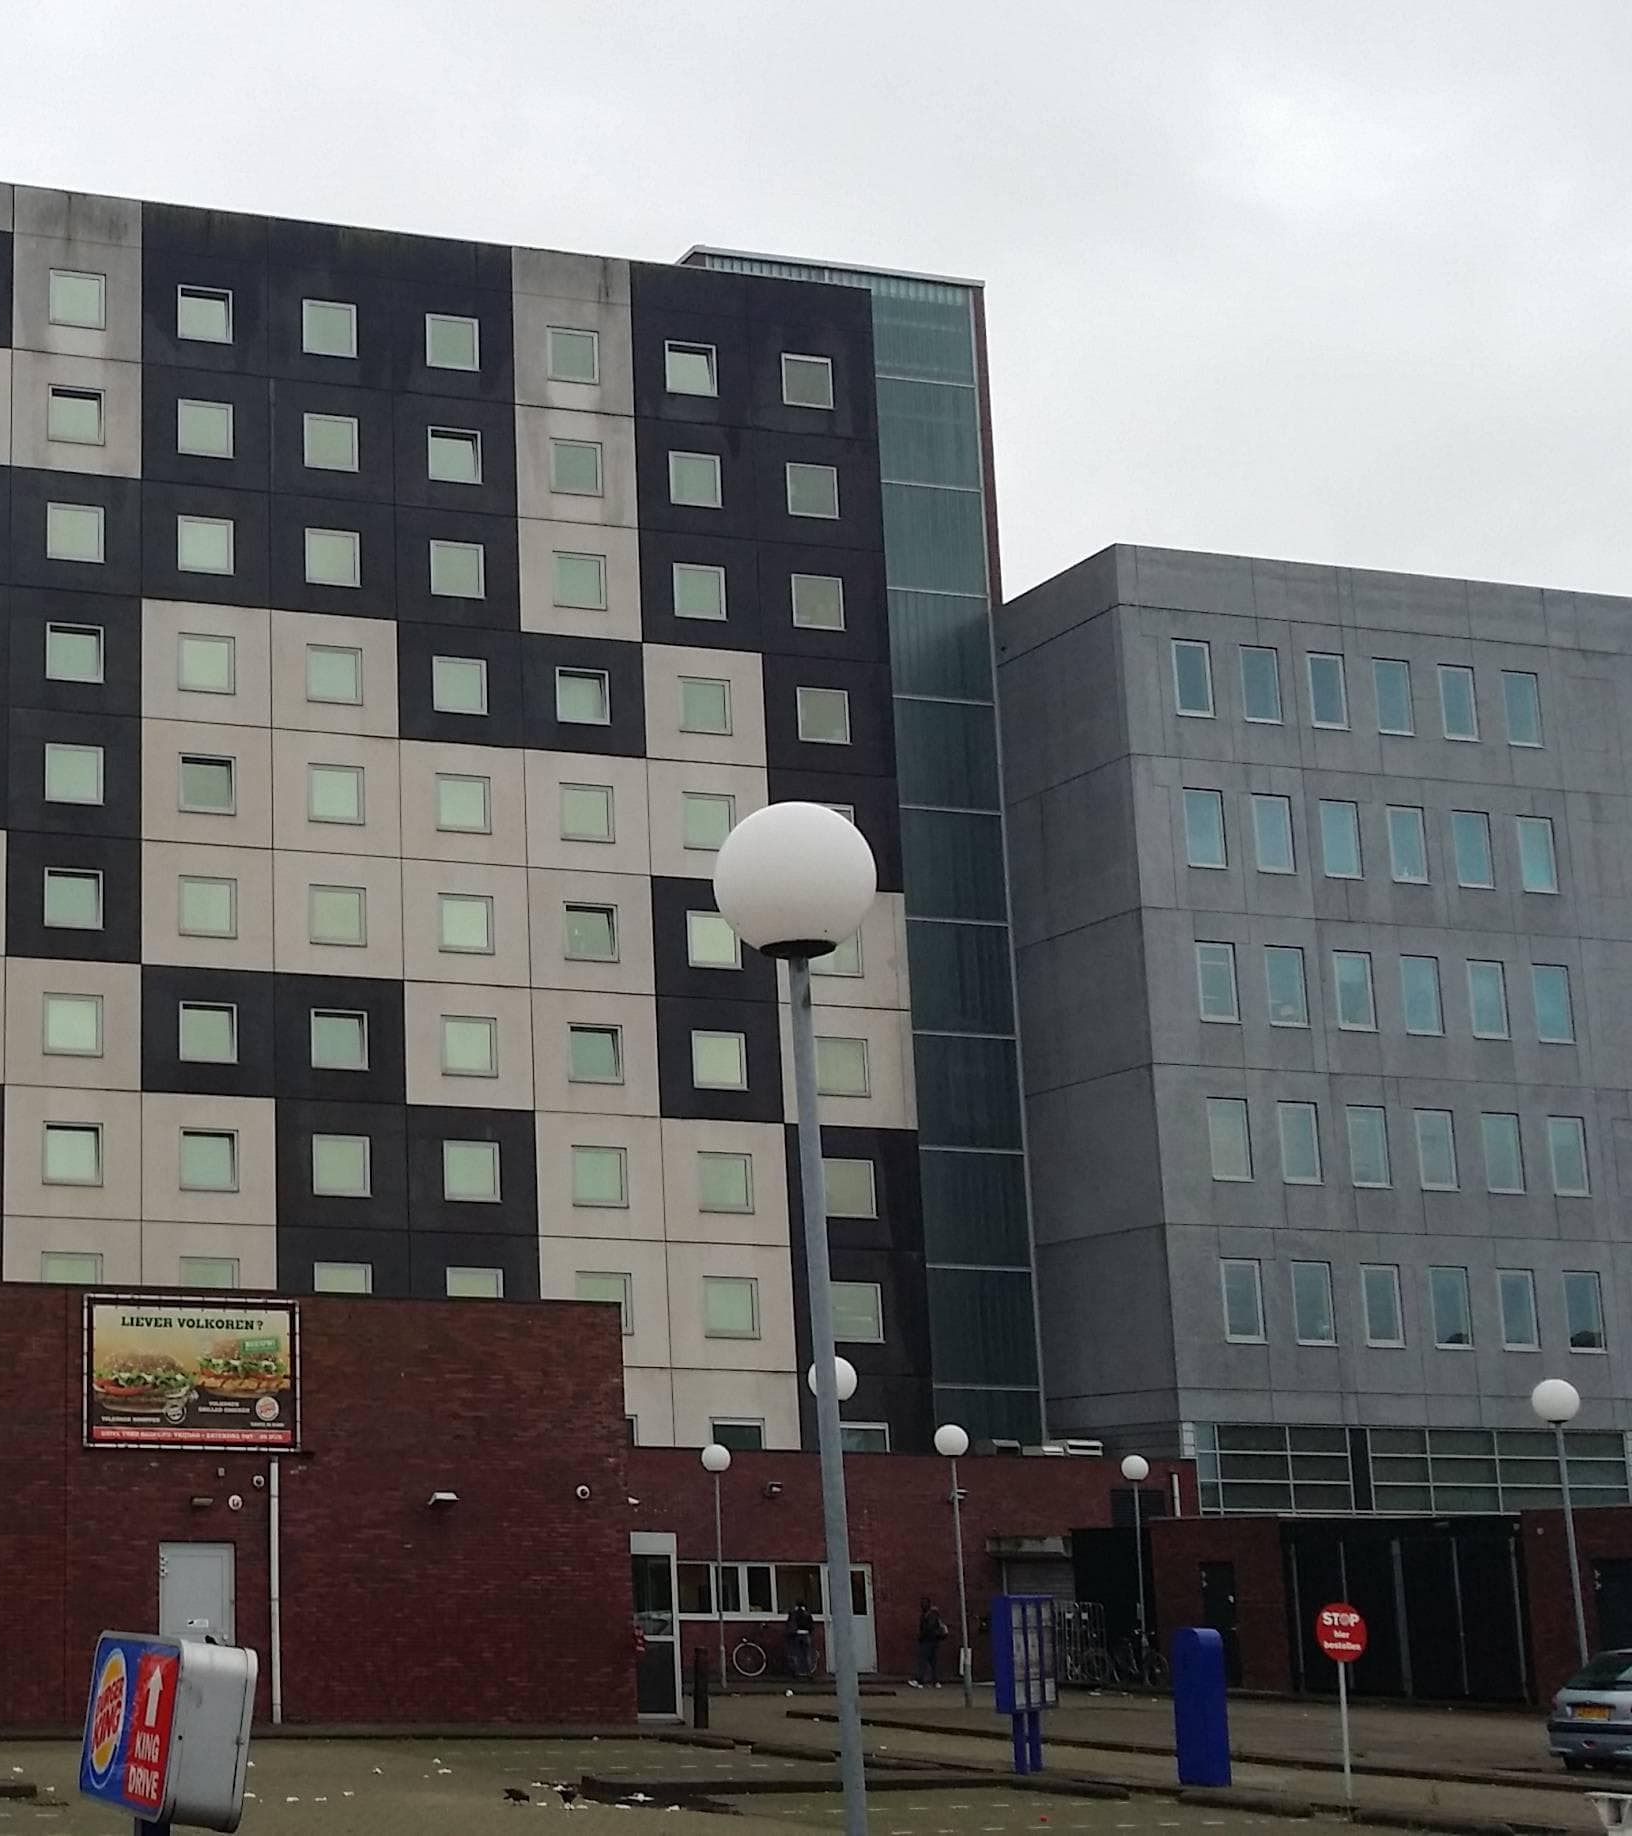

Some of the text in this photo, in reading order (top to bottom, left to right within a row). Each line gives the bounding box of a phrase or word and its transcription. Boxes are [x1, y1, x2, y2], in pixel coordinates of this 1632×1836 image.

[121, 1316, 173, 1328] LIEVER
[1322, 1611, 1360, 1627] STOP
[1323, 1640, 1362, 1651] bestellen
[1333, 1629, 1350, 1639] hier
[96, 1676, 125, 1719] BURGER
[92, 1700, 122, 1753] KING
[134, 1731, 160, 1762] KING
[128, 1766, 157, 1800] DRIVE
